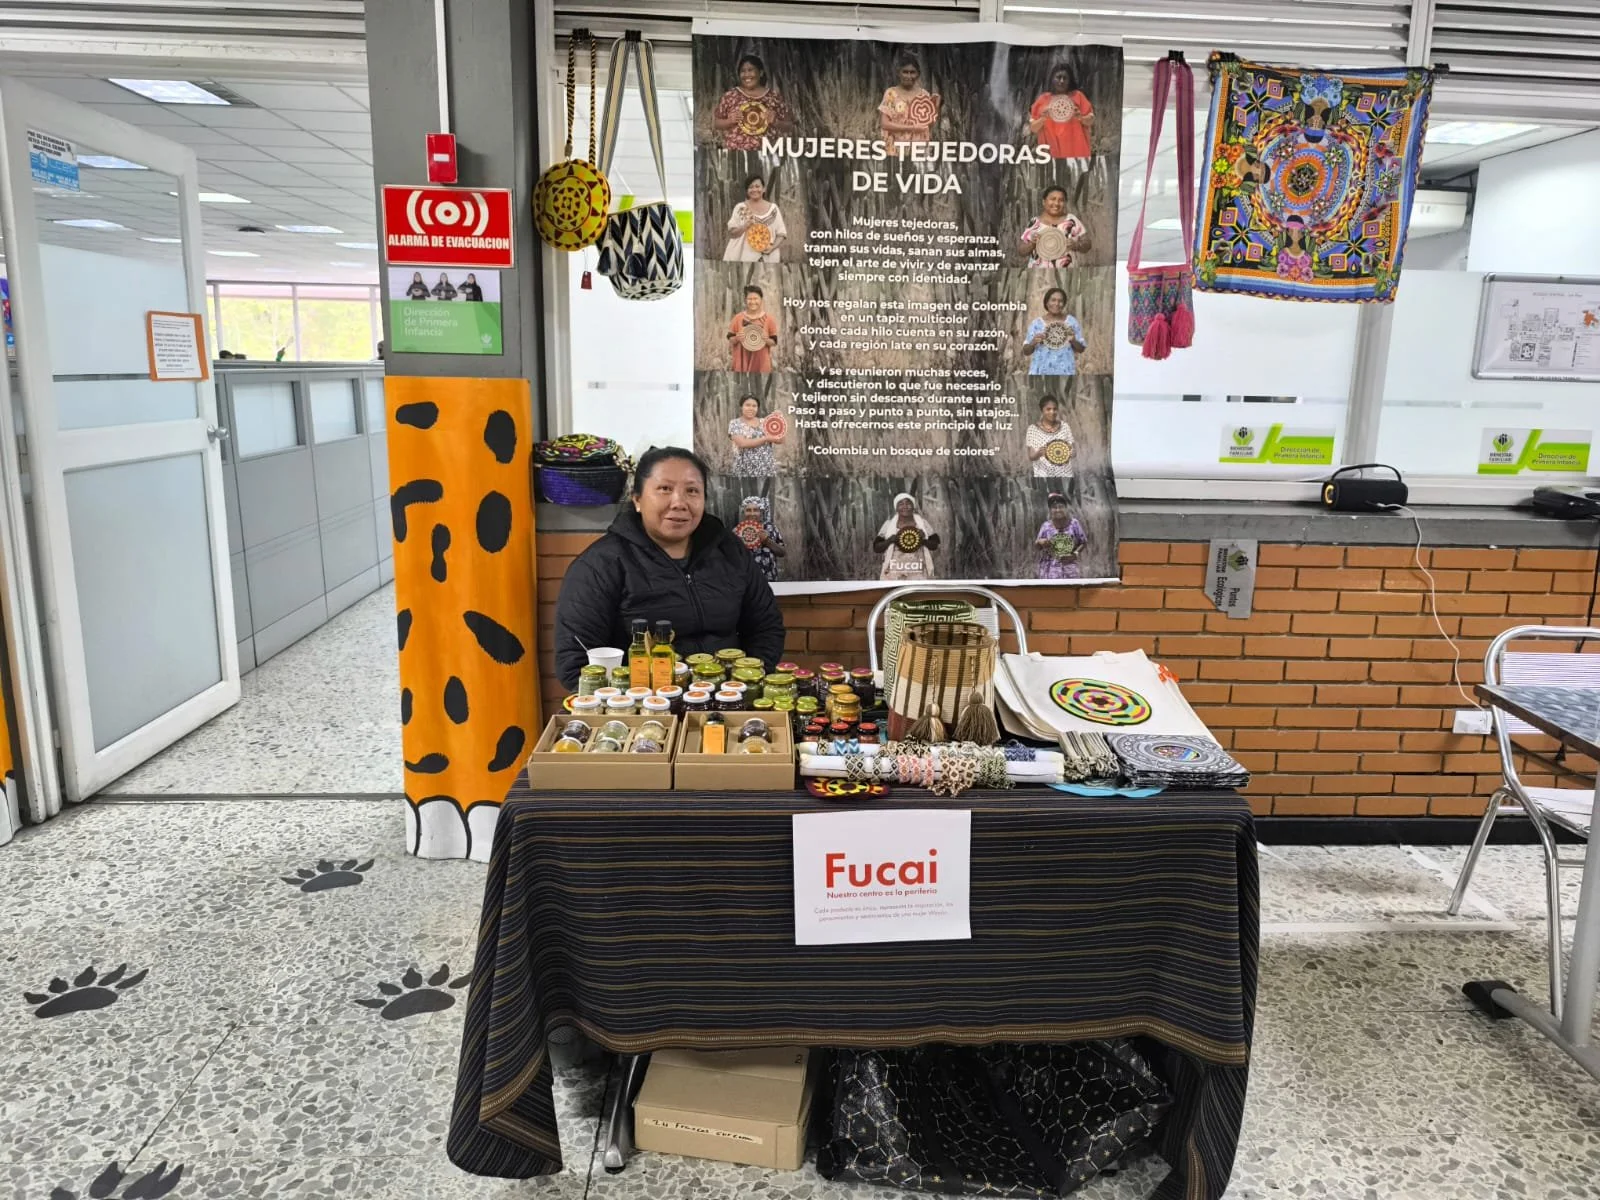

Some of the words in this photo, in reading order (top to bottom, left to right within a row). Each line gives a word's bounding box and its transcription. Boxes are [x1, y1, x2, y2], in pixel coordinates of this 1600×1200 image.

[762, 137, 887, 161] MUJERES
[894, 141, 1050, 164] TEJEDORAS
[852, 171, 888, 192] DE
[896, 173, 962, 194] VIDA
[853, 216, 898, 230] Mujeres
[902, 218, 958, 231] tejedoras,
[389, 234, 429, 247] ALARMA
[432, 236, 444, 247] DE
[446, 236, 509, 249] EVACUACION
[836, 228, 863, 239] hilos
[866, 229, 880, 240] de
[884, 231, 925, 242] sueños
[928, 234, 934, 244] y
[938, 235, 999, 245] esperanza,
[804, 244, 846, 253] traman
[872, 245, 905, 256] vidas,
[909, 248, 942, 256] sanan
[946, 249, 964, 257] sus
[968, 247, 1005, 259] almas,
[809, 258, 839, 269] tejen
[843, 258, 853, 267] el
[856, 260, 879, 268] arte
[883, 259, 896, 269] de
[900, 260, 924, 269] vivir
[927, 262, 934, 272] y
[937, 260, 951, 270] de
[954, 262, 999, 271] avanzar
[838, 271, 885, 284] siempre
[888, 274, 909, 282] con
[912, 272, 970, 284] identidad.
[404, 306, 450, 317] Dirección
[784, 298, 805, 309] Hoy
[834, 299, 876, 310] regalan
[881, 300, 904, 309] esta
[908, 300, 951, 312] imagen
[955, 301, 968, 311] de
[972, 301, 1027, 311] Colombia
[404, 317, 416, 326] de
[420, 318, 458, 327] Primera
[877, 314, 905, 325] tapiz
[909, 314, 967, 324] multicolor
[405, 328, 443, 336] Infancia
[800, 326, 837, 335] donde
[840, 326, 867, 336] cada
[872, 327, 892, 336] hilo
[896, 329, 935, 337] cuenta
[973, 328, 1008, 339] razón,
[810, 341, 816, 350] y
[820, 340, 847, 349] cada
[851, 340, 888, 351] región
[891, 340, 912, 350] late
[950, 341, 998, 351] corazón.
[819, 367, 826, 375] Y
[846, 367, 901, 377] reunieron
[905, 367, 950, 377] muchas
[953, 369, 988, 379] veces,
[806, 380, 814, 388] Y
[817, 380, 882, 389] discutieron
[886, 380, 895, 390] lo
[899, 382, 921, 392] que
[924, 381, 942, 390] fue
[946, 382, 1001, 391] necesario
[792, 393, 799, 401] Y
[802, 392, 846, 404] tejieron
[851, 394, 867, 402] sin
[870, 393, 924, 403] descanso
[928, 394, 972, 404] durante
[994, 395, 1015, 404] año
[788, 406, 815, 415] Paso
[829, 408, 856, 418] paso
[859, 409, 865, 418] y
[869, 408, 903, 418] punto
[916, 408, 953, 419] punto,
[957, 408, 972, 417] sin
[976, 408, 1019, 419] atajos...
[795, 420, 828, 429] Hasta
[832, 420, 894, 430] ofrecernos
[897, 422, 921, 430] este
[925, 420, 975, 432] principio
[978, 420, 992, 430] de
[996, 421, 1012, 430] luz
[890, 446, 932, 458] bosque
[936, 446, 950, 456] de
[890, 559, 923, 570] Fucai
[1228, 588, 1240, 607] Puntos
[826, 848, 938, 888] Fucai
[827, 891, 857, 899] Nuestro
[859, 889, 882, 897] centro
[904, 887, 938, 897] periferia
